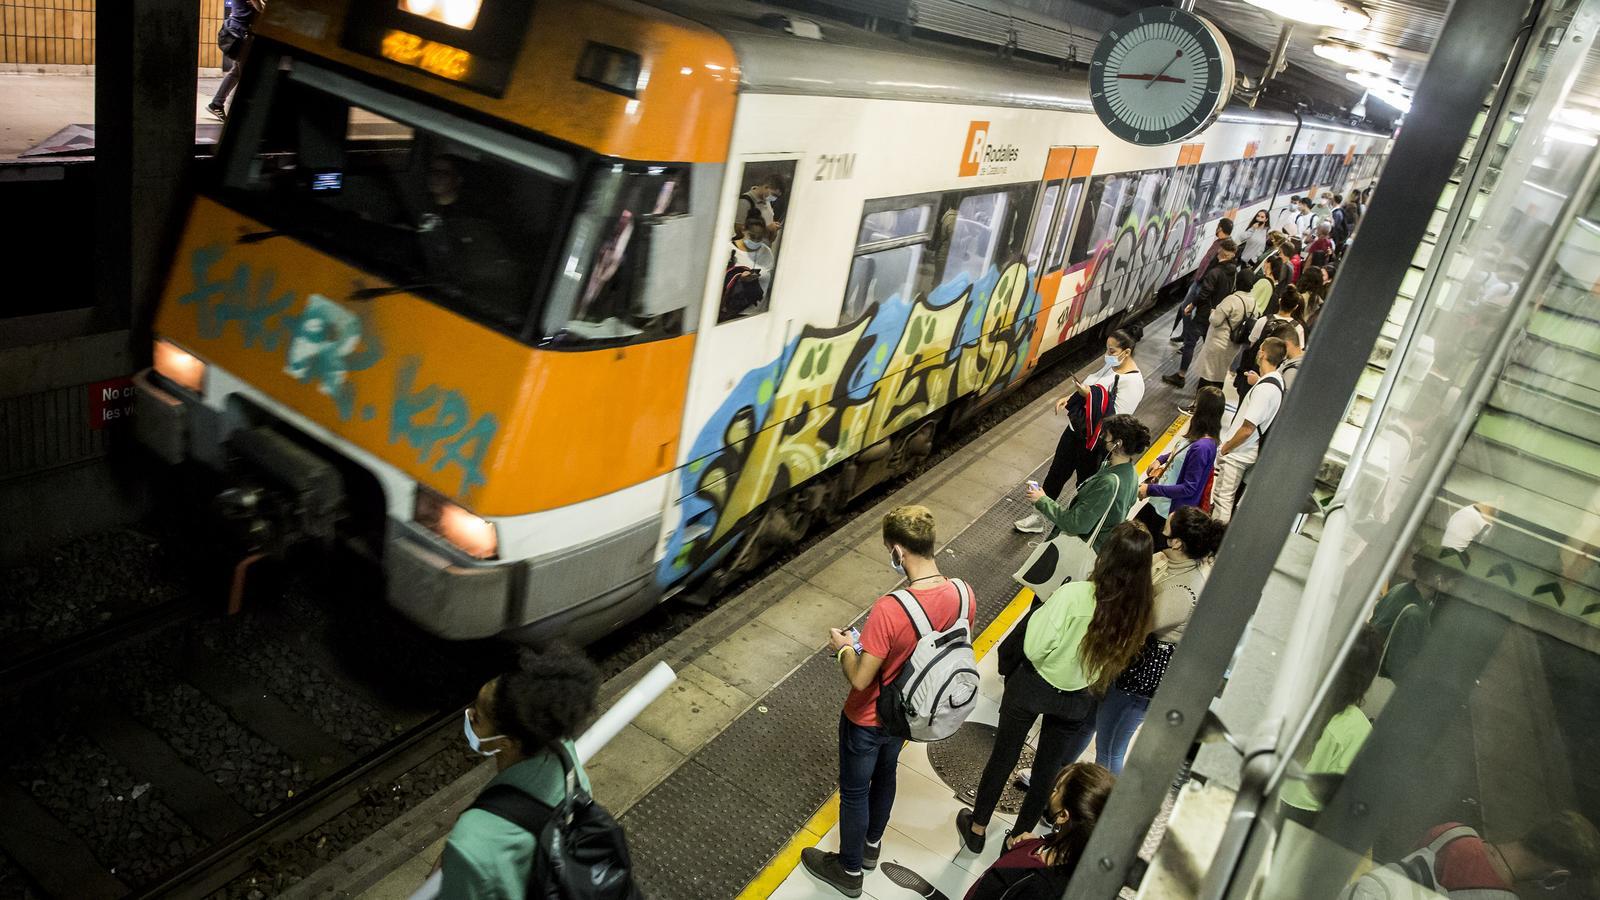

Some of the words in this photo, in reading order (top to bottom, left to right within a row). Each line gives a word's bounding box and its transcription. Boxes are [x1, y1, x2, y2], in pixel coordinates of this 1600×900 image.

[983, 143, 1019, 162] Rodalies
[814, 152, 857, 181] 211M
[102, 387, 120, 402] No
[102, 407, 121, 421] les
